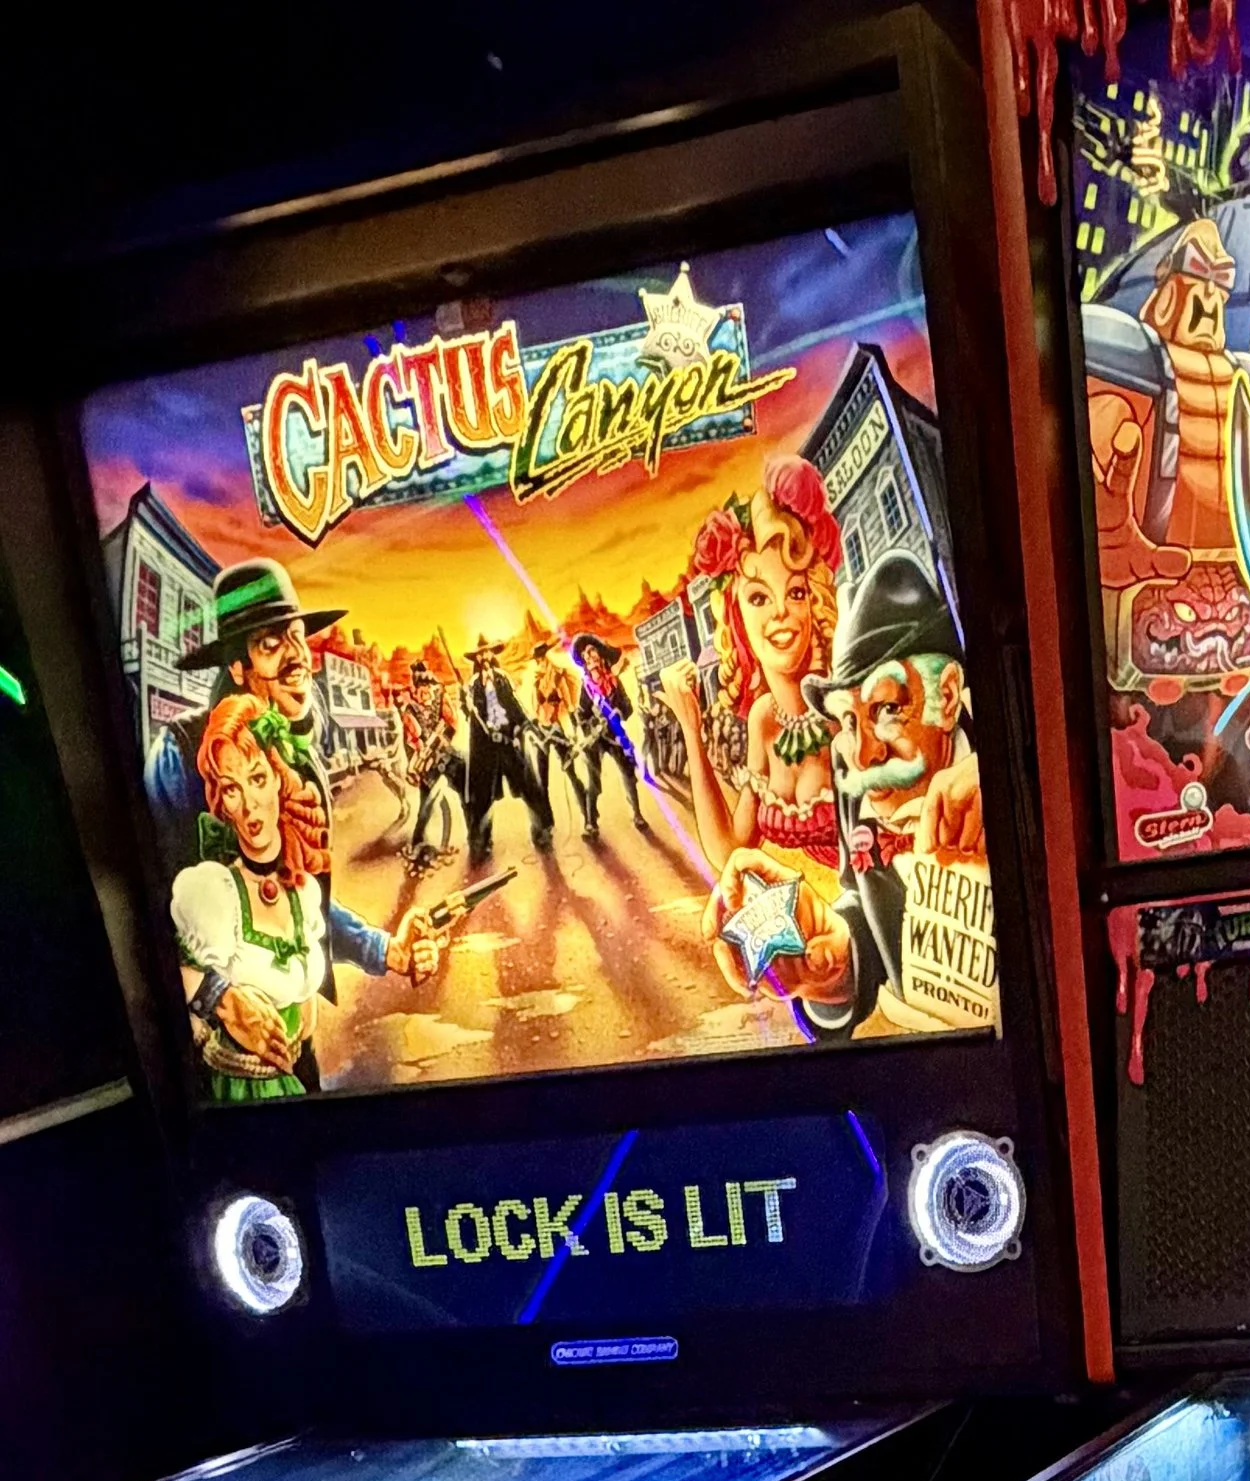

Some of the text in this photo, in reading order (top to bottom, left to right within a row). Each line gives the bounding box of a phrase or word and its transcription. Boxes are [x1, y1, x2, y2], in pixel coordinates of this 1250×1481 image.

[263, 322, 796, 547] CACTUS Canyon
[825, 406, 886, 504] SALOON
[1144, 812, 1205, 839] Stern
[909, 915, 997, 989] WANTED
[911, 976, 989, 1019] PRONTO!
[406, 1176, 796, 1267] LOCK IS LIT
